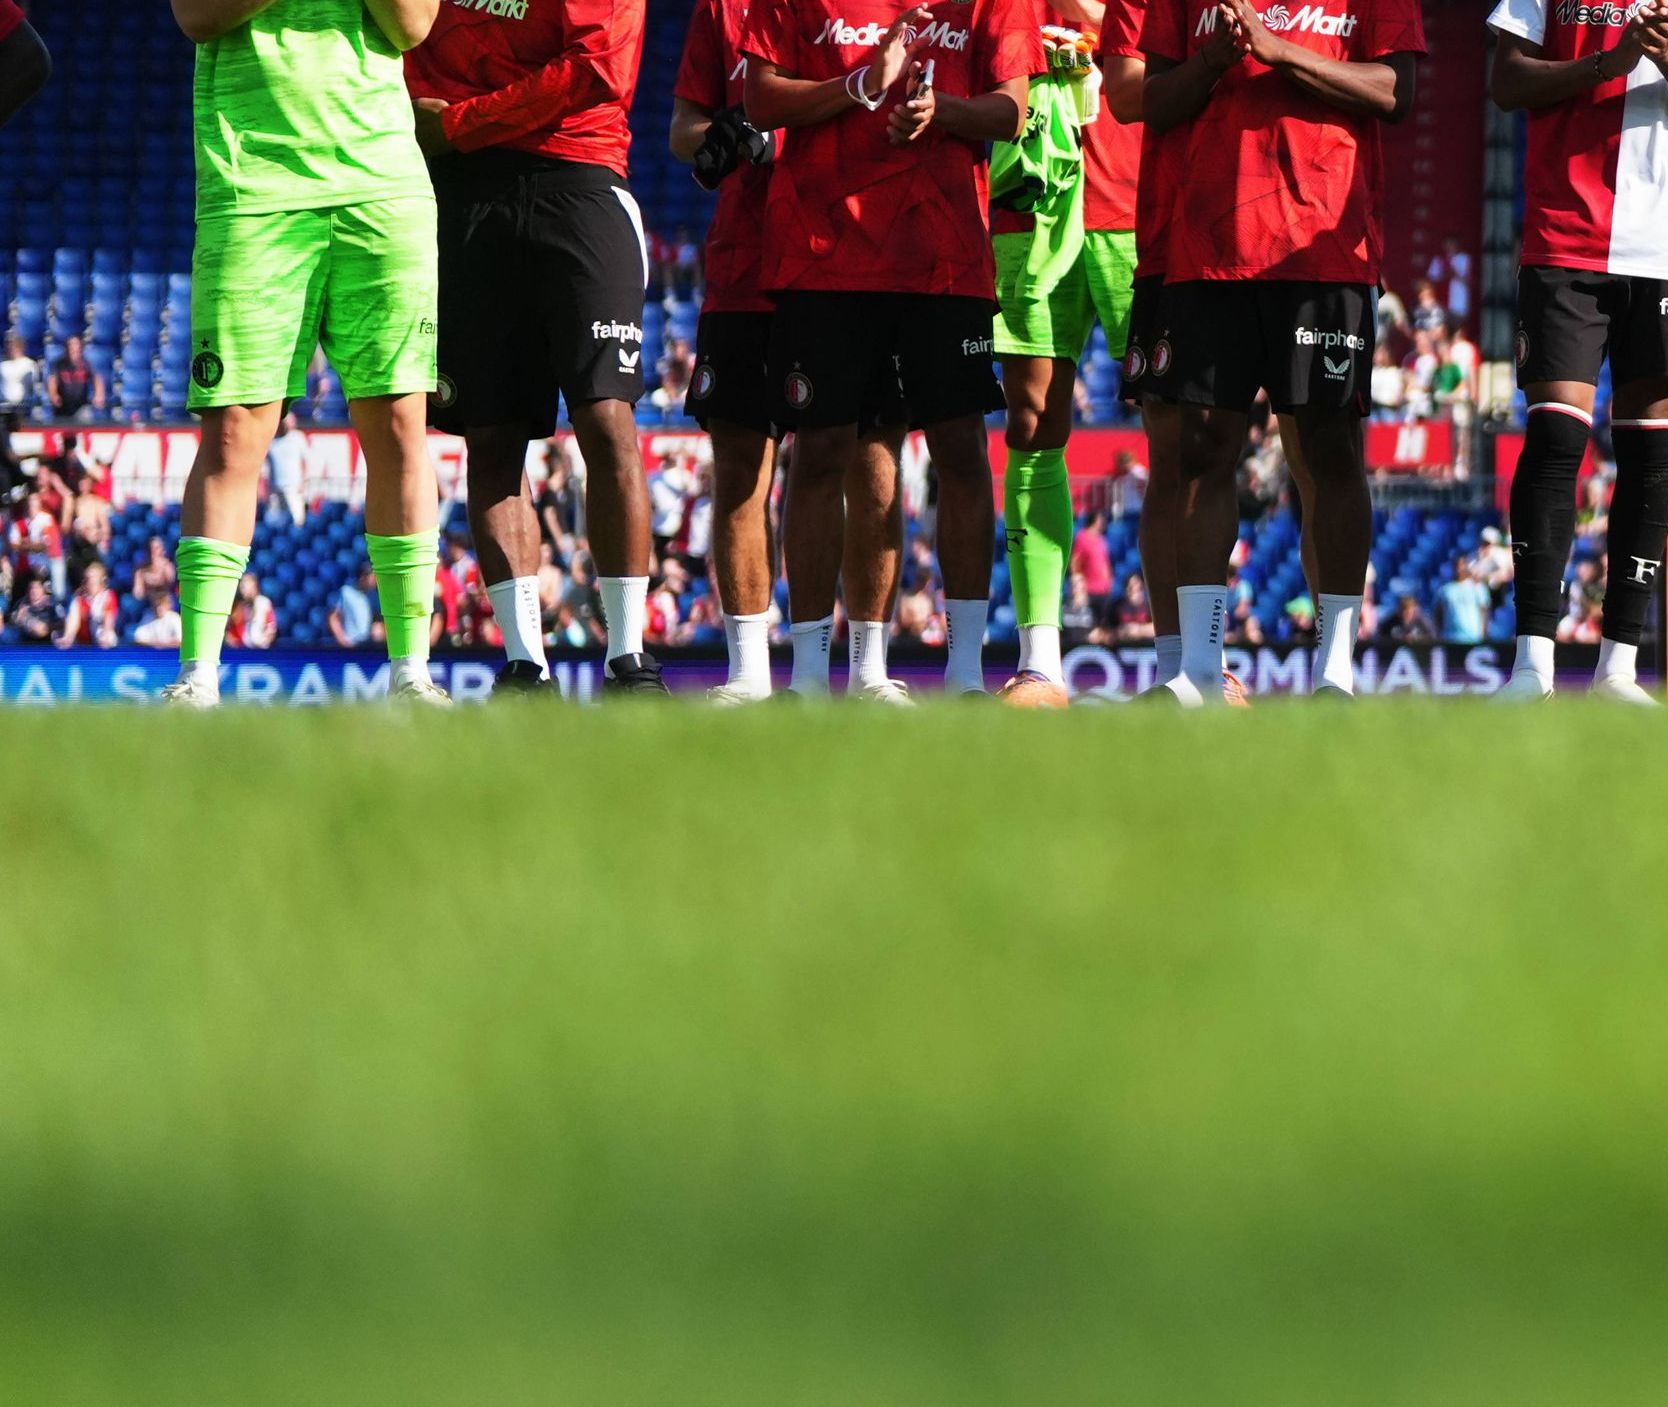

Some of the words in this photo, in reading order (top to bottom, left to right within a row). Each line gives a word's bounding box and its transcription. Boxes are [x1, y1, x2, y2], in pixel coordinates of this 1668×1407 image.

[1285, 5, 1358, 38] Markt
[1295, 327, 1365, 352] fairphone
[1209, 598, 1223, 645] CASTORE
